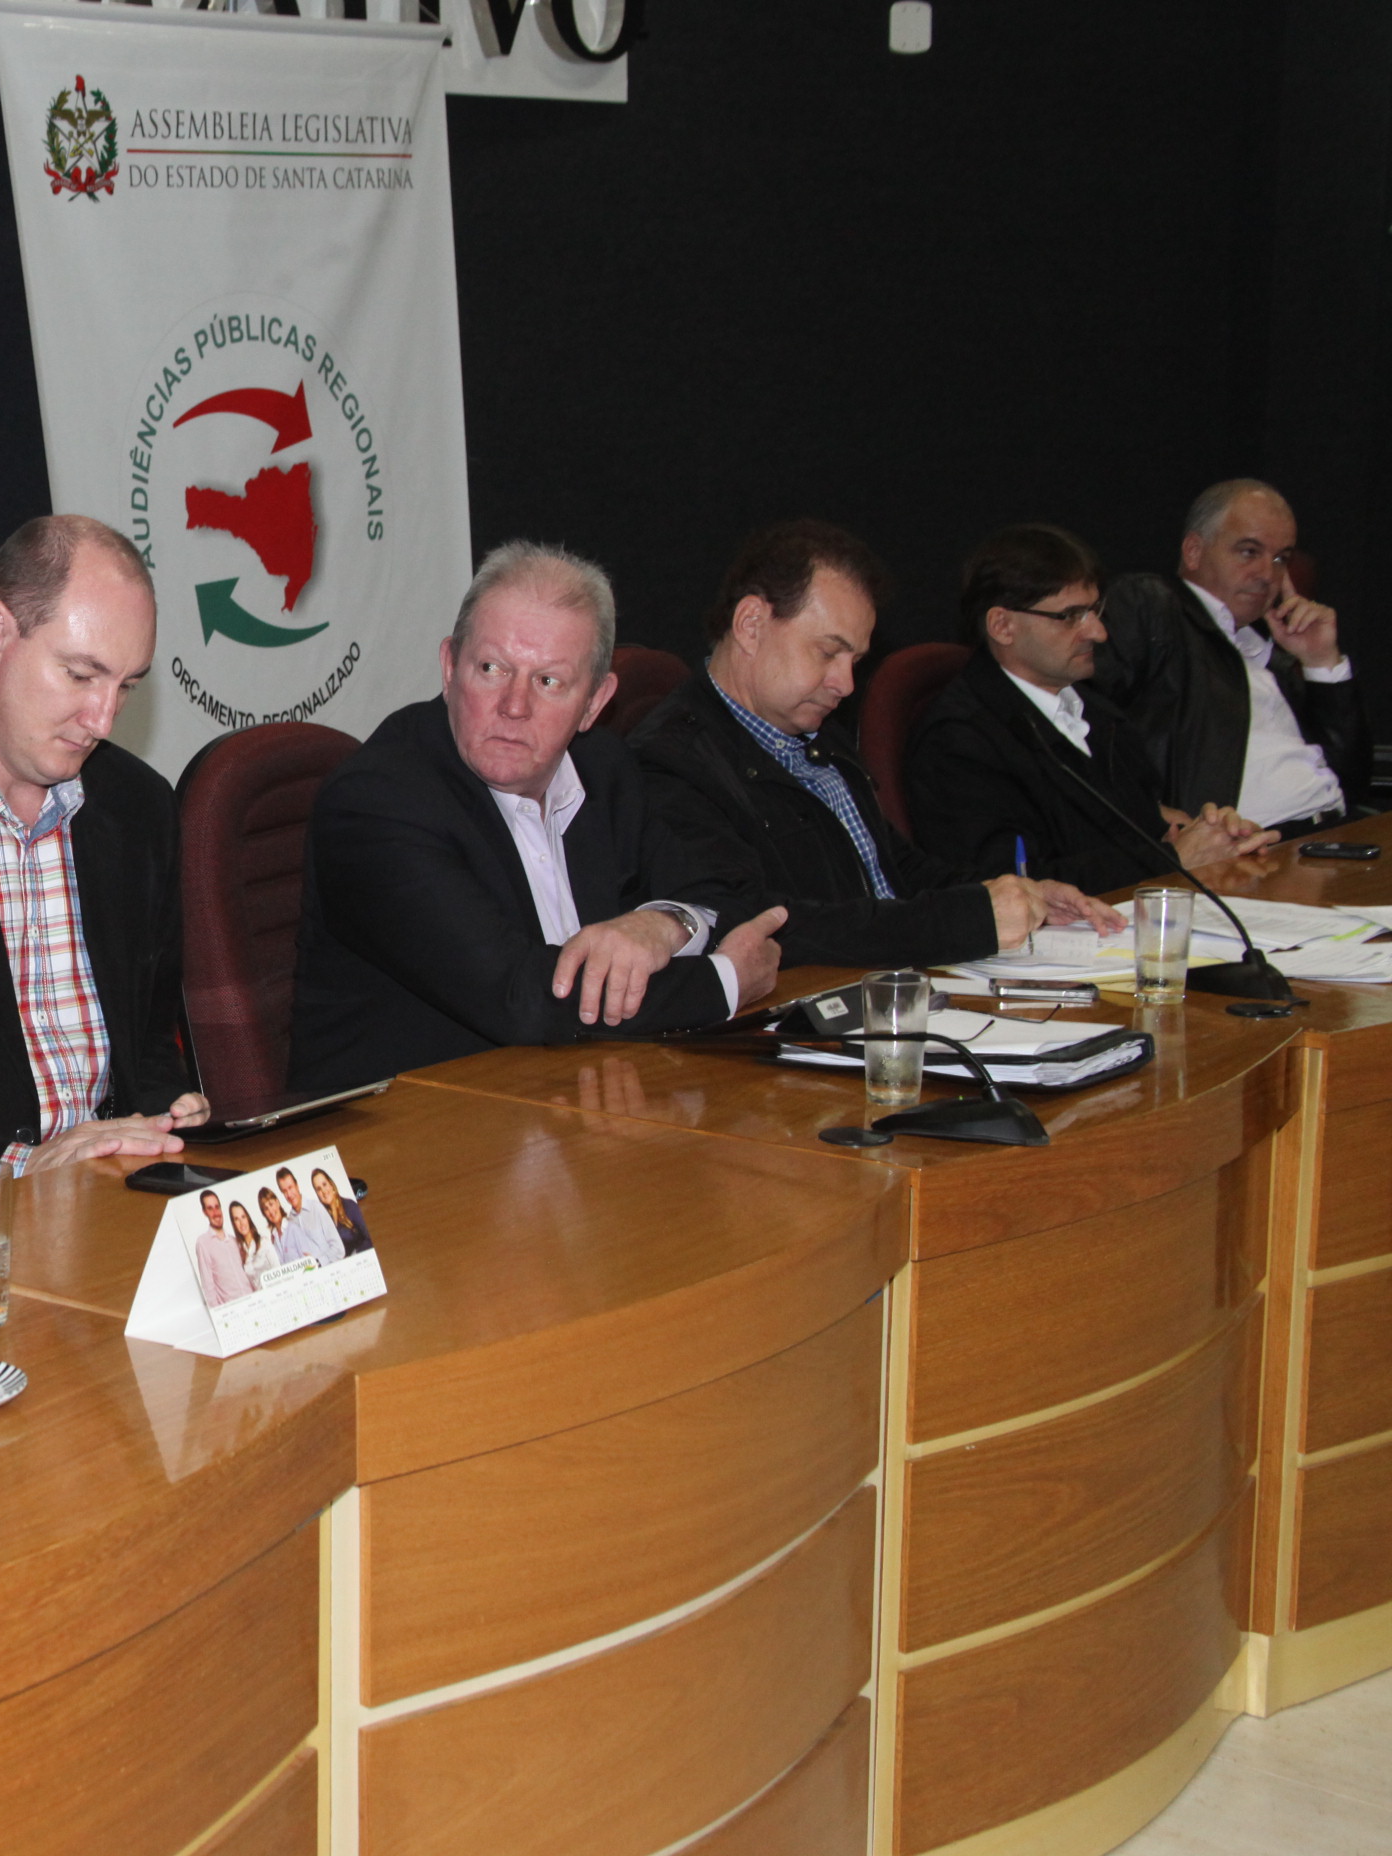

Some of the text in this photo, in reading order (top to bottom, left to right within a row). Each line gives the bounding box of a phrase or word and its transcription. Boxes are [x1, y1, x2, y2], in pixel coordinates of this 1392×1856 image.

[130, 109, 412, 145] ASSEMBLEIA LEGISLATIVA
[128, 164, 158, 189] DO
[166, 165, 239, 190] ESTADO
[245, 165, 267, 190] DE
[272, 166, 328, 190] SANTA
[333, 166, 414, 190] CATARINA
[129, 313, 383, 569] AUDIÊNCIAS PÚBLICAS REGIONAIS
[172, 656, 256, 730] ORÇAMENTO
[263, 1270, 282, 1282] CELSO
